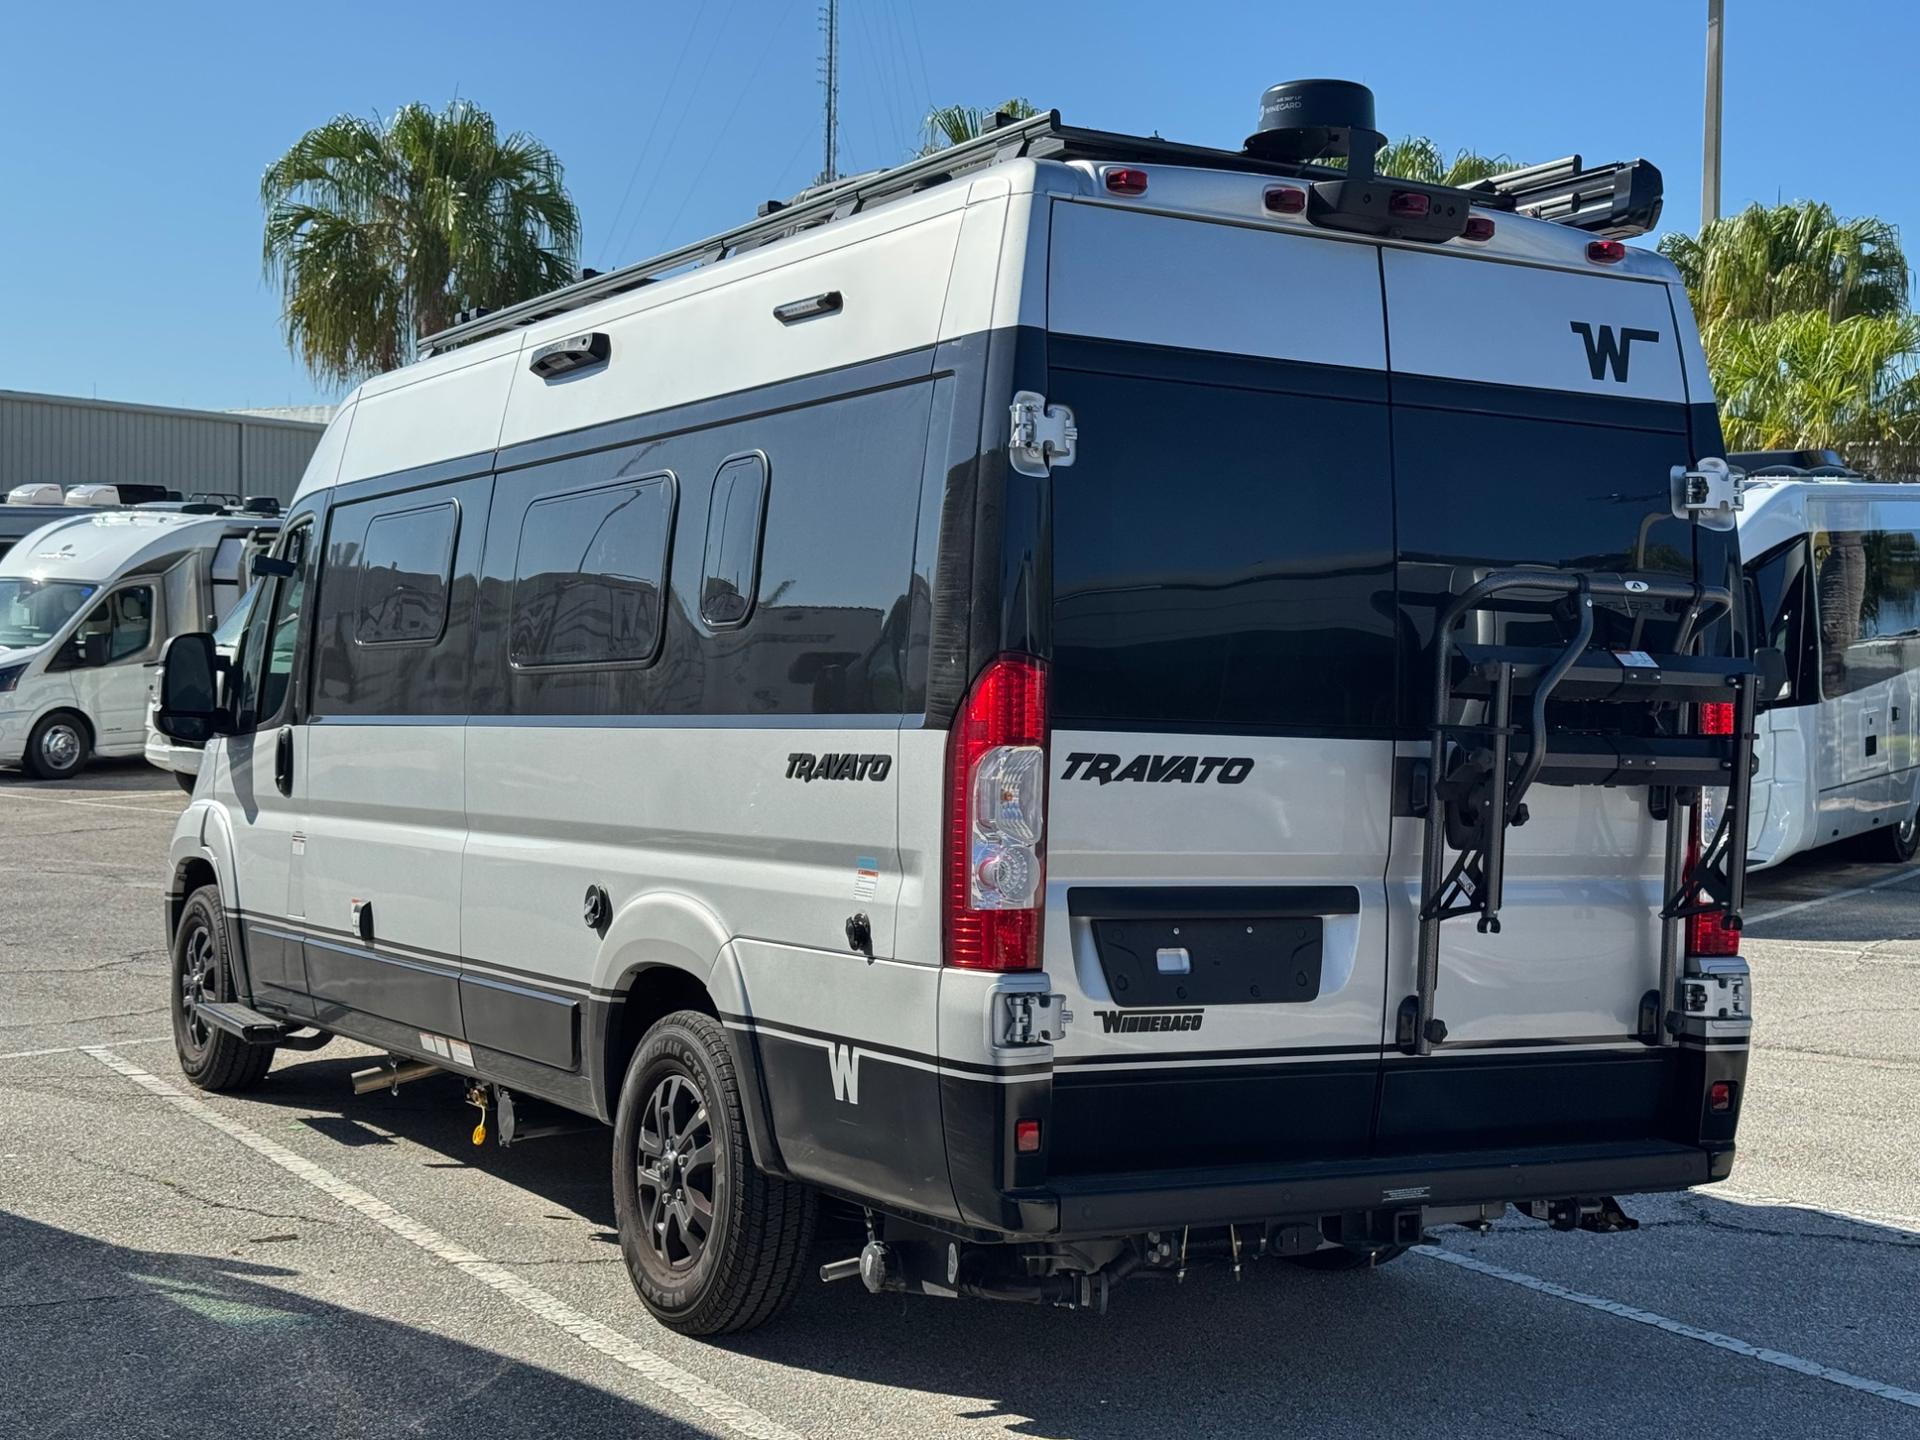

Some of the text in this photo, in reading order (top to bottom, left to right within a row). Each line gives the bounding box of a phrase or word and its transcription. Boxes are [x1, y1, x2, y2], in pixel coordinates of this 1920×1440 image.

[1570, 321, 1659, 383] W
[785, 753, 892, 783] TRAVATO
[1061, 752, 1254, 786] TRAVATO
[1093, 1008, 1205, 1033] WINNEBAGO
[637, 1040, 682, 1067] OADIAN
[828, 1042, 860, 1105] W
[632, 1261, 686, 1307] NEXEN
